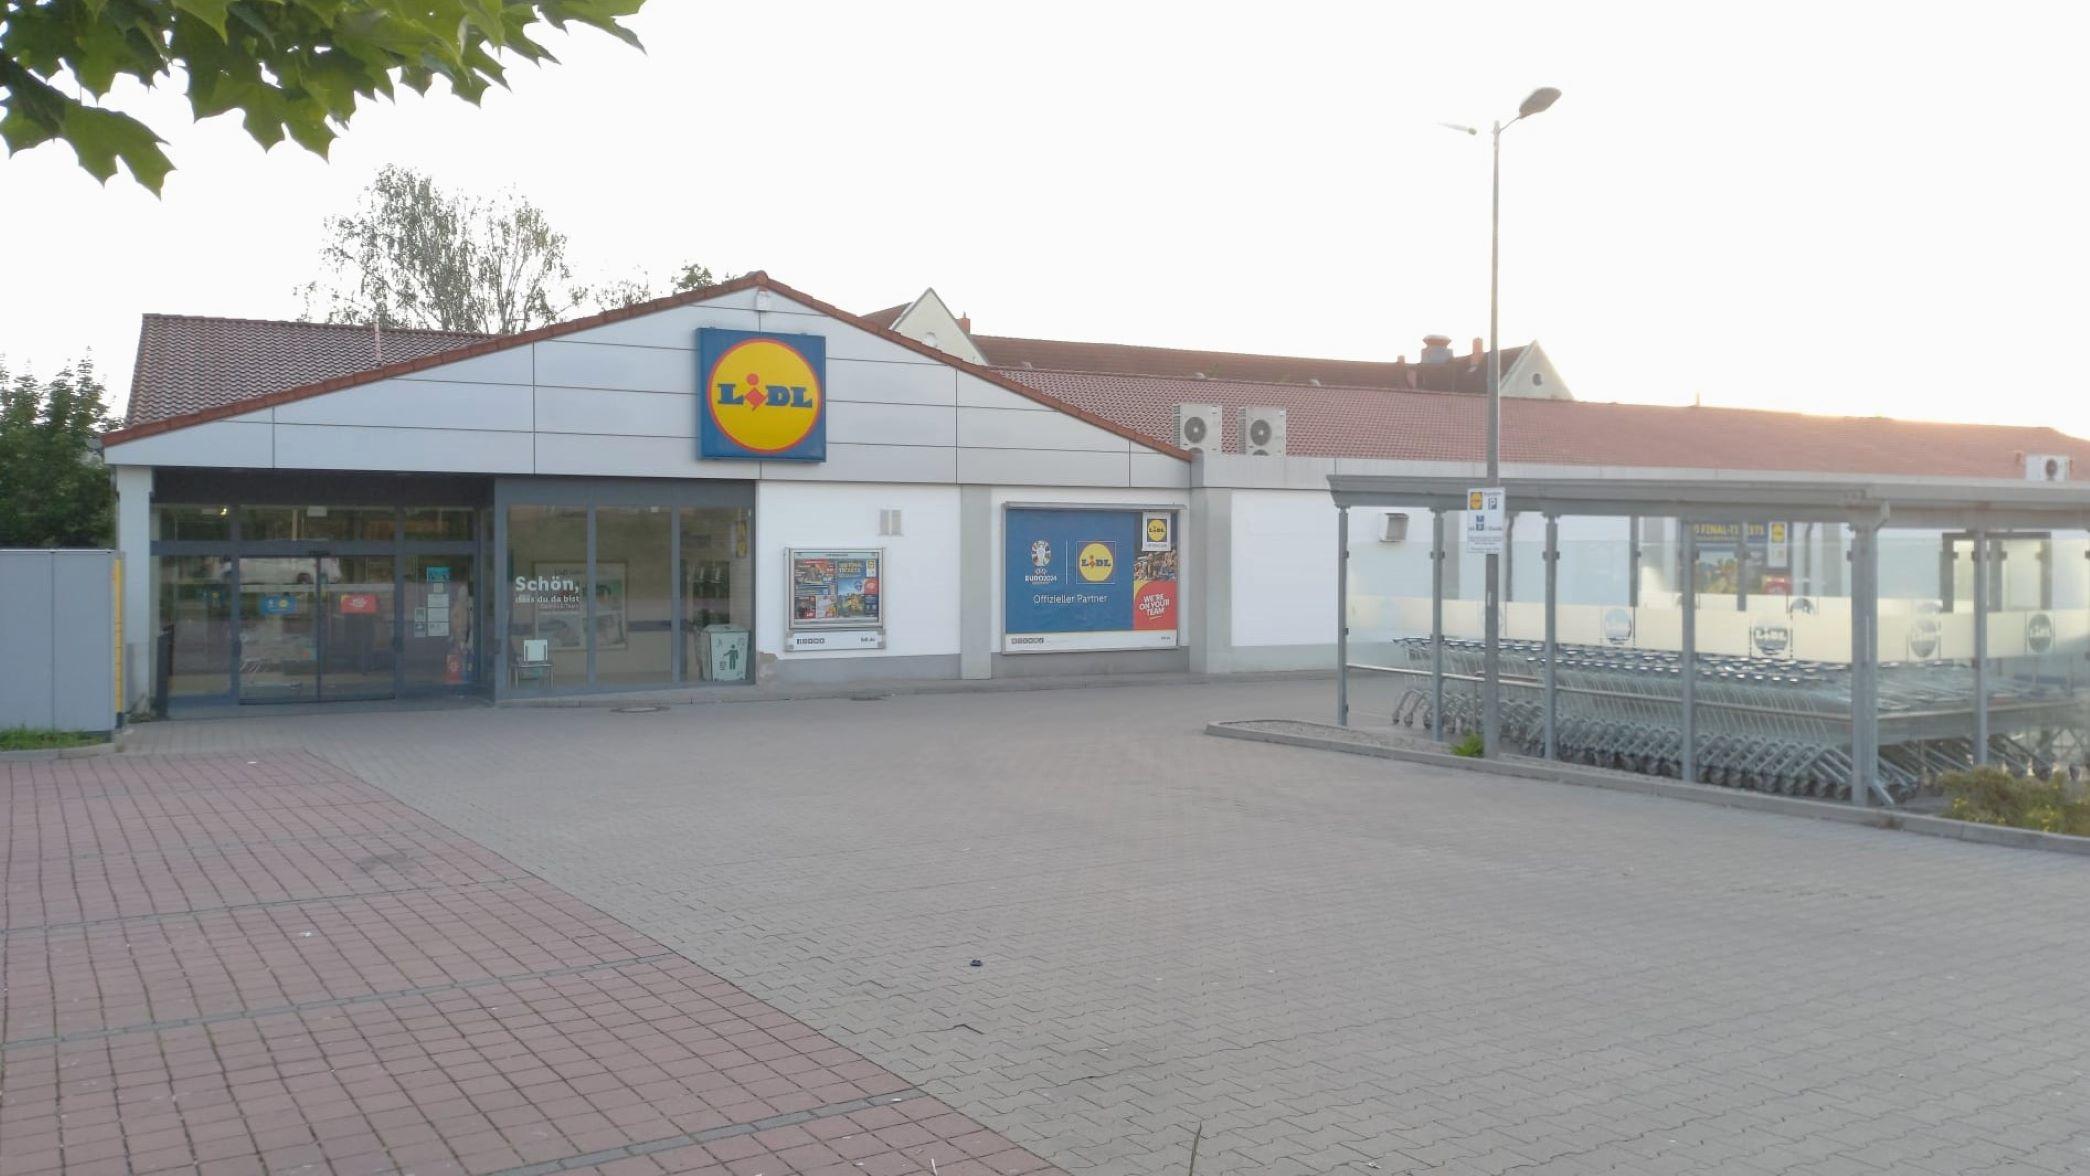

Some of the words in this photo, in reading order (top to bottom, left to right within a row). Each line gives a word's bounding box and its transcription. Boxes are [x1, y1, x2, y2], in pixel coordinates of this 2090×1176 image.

[515, 576, 580, 594] Schön,
[537, 594, 549, 602] du
[1033, 594, 1074, 604] Offizieller
[1077, 594, 1108, 603] Partner
